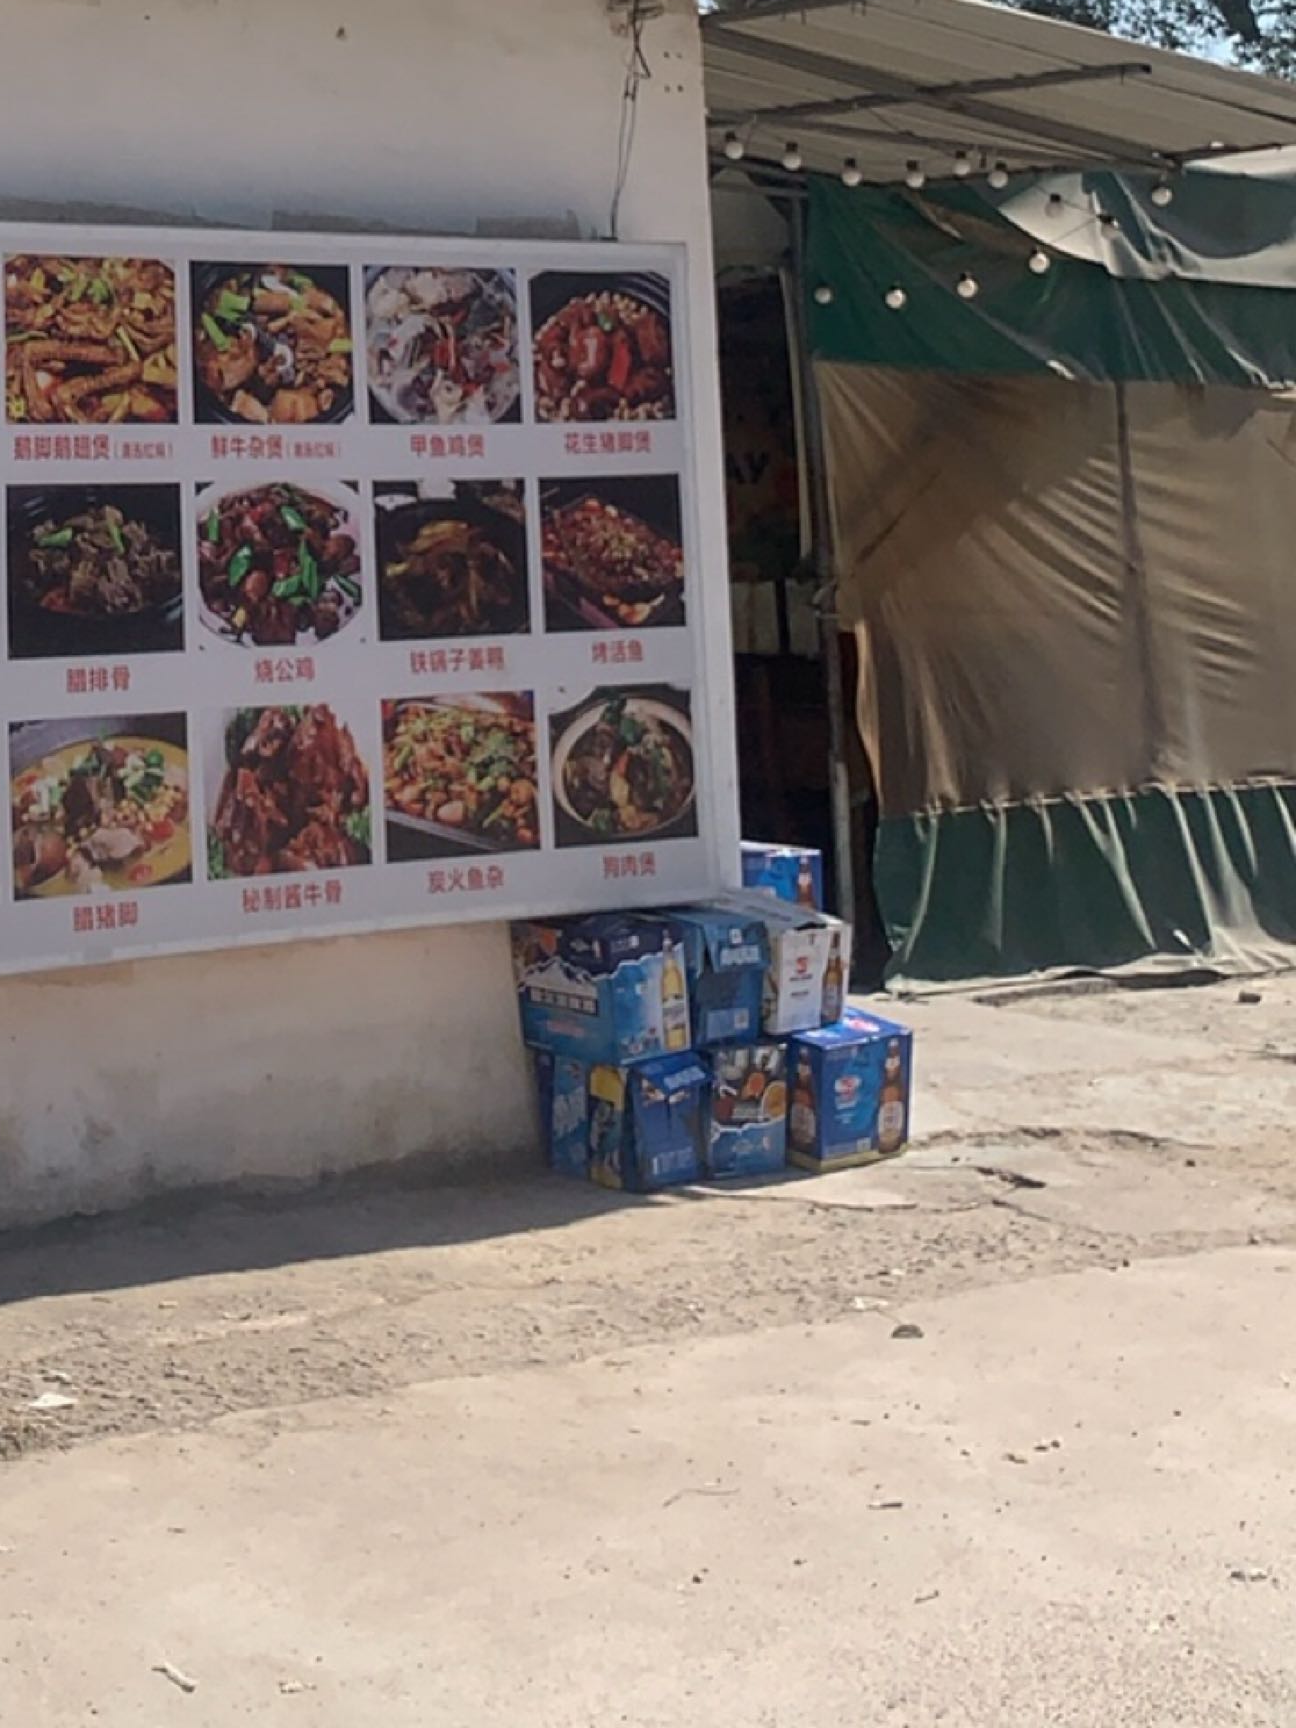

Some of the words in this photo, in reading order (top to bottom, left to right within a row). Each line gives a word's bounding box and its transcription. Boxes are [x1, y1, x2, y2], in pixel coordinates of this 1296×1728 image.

[428, 865, 504, 894] 炭火鱼杂
[241, 879, 342, 913] 秘制酱牛骨
